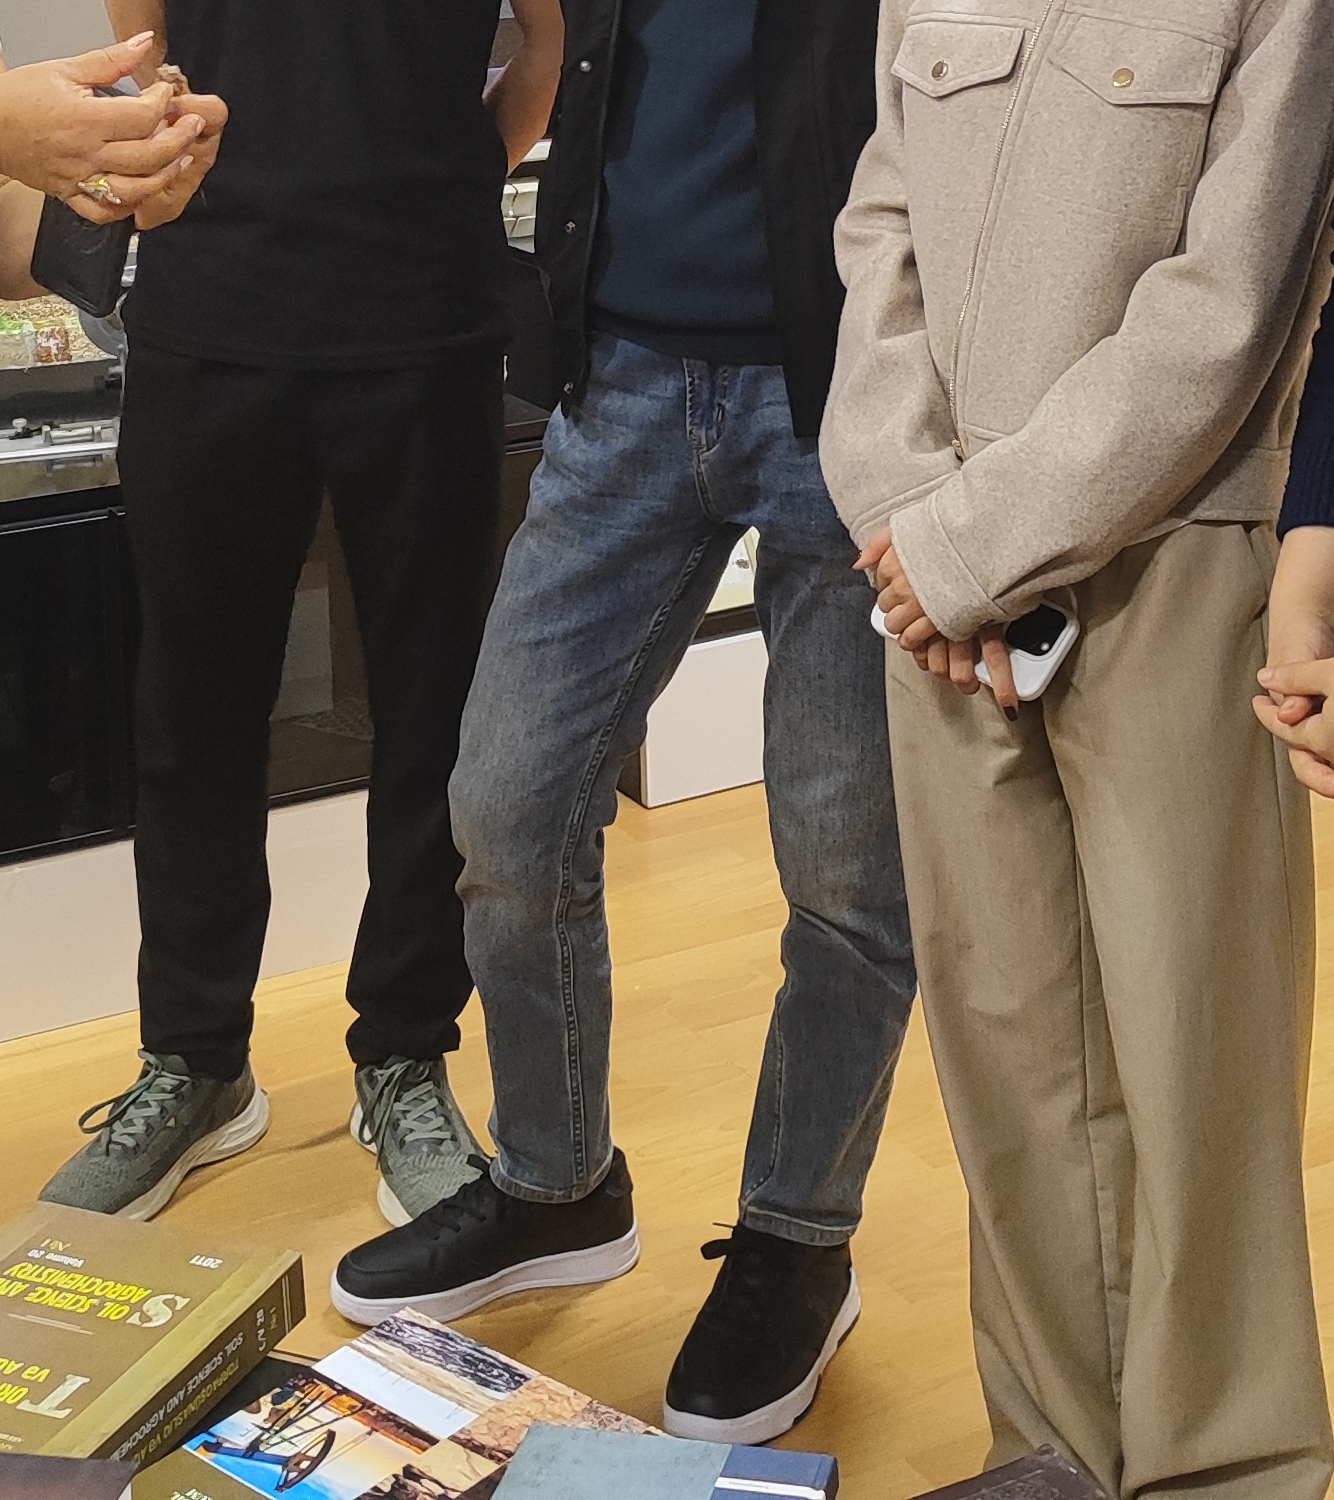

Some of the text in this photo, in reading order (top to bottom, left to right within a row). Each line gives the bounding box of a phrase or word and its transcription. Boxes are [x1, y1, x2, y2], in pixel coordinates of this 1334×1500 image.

[44, 1250, 86, 1270] Volume
[188, 1253, 225, 1270] 2011
[1, 1261, 153, 1304] AGROCHEMISTRY
[24, 1285, 99, 1315] SCIENCE
[224, 1331, 244, 1357] SOIL
[185, 1351, 224, 1392] SCIENCE
[166, 1387, 187, 1413] AND
